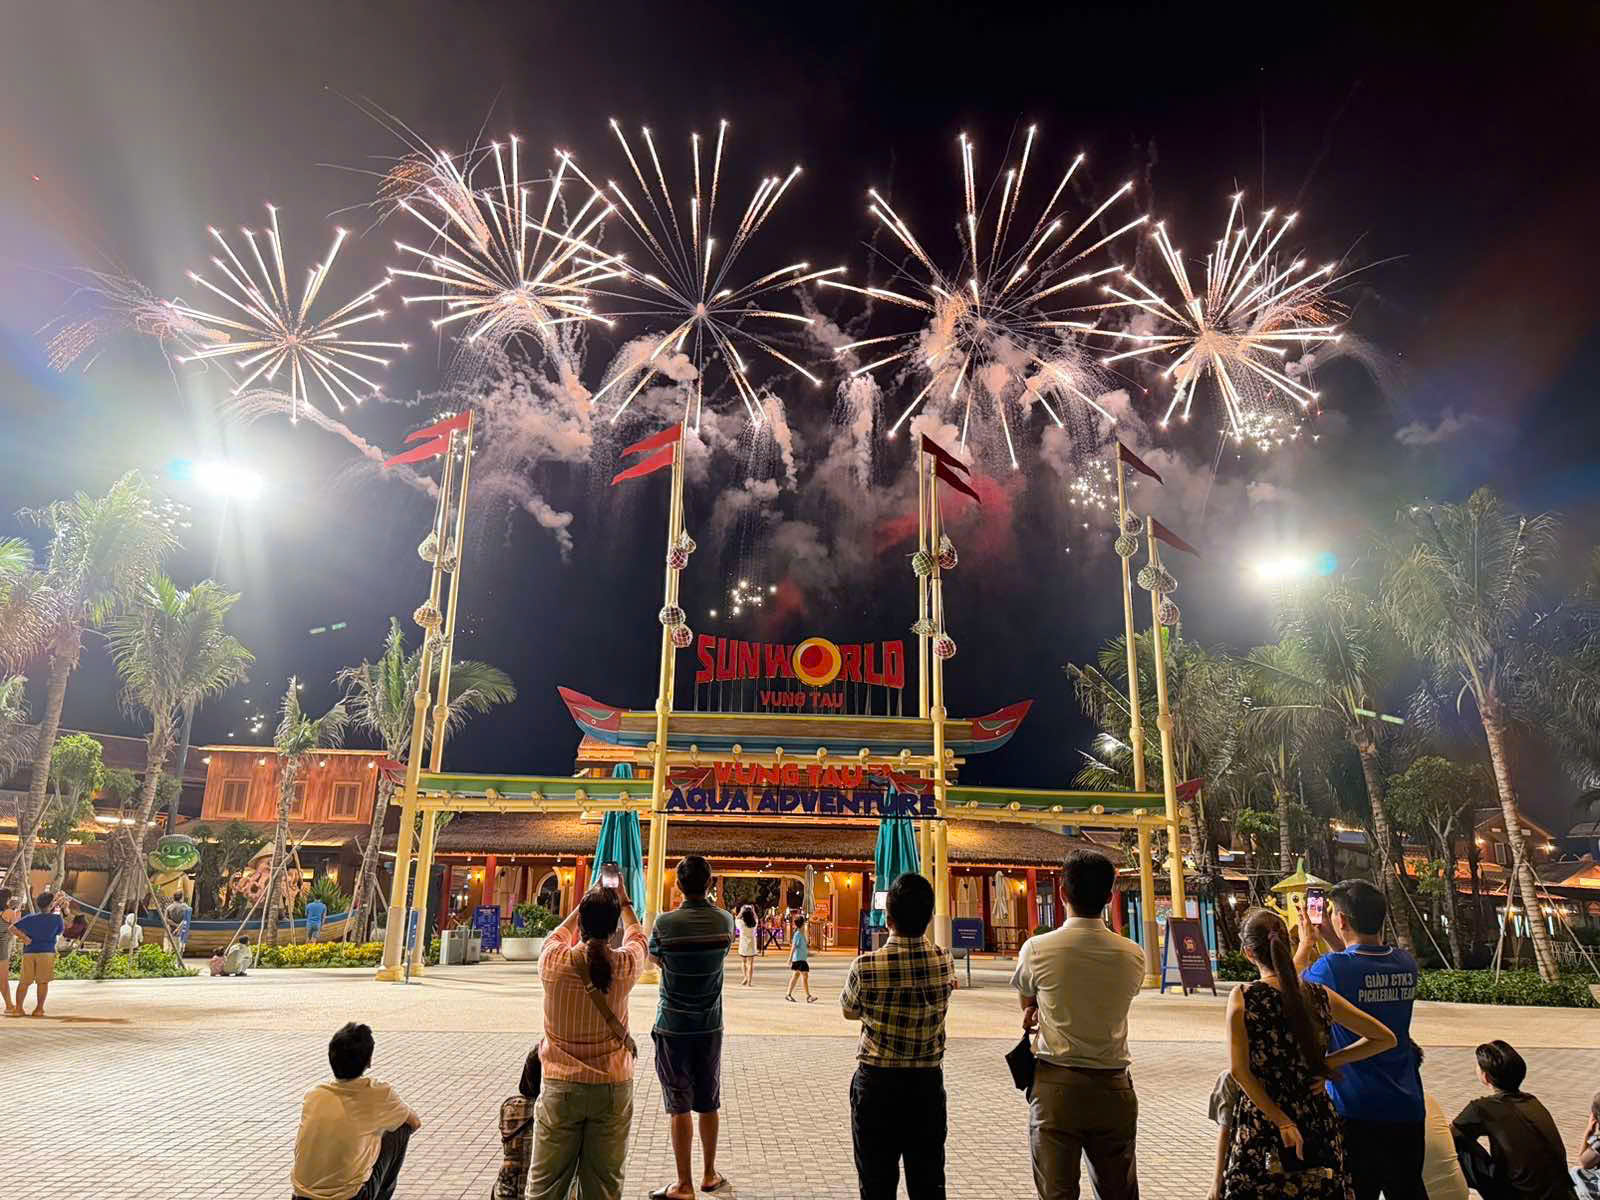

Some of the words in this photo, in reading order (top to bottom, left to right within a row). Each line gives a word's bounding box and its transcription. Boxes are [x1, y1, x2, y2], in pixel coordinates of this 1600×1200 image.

[760, 690, 805, 707] VUNG
[811, 691, 845, 709] TAU
[713, 761, 800, 786] VUNG
[807, 763, 863, 789] TAU
[666, 787, 750, 812] AQUA
[757, 789, 937, 816] ADVENTURE
[1358, 988, 1399, 1002] PICKLEBALL
